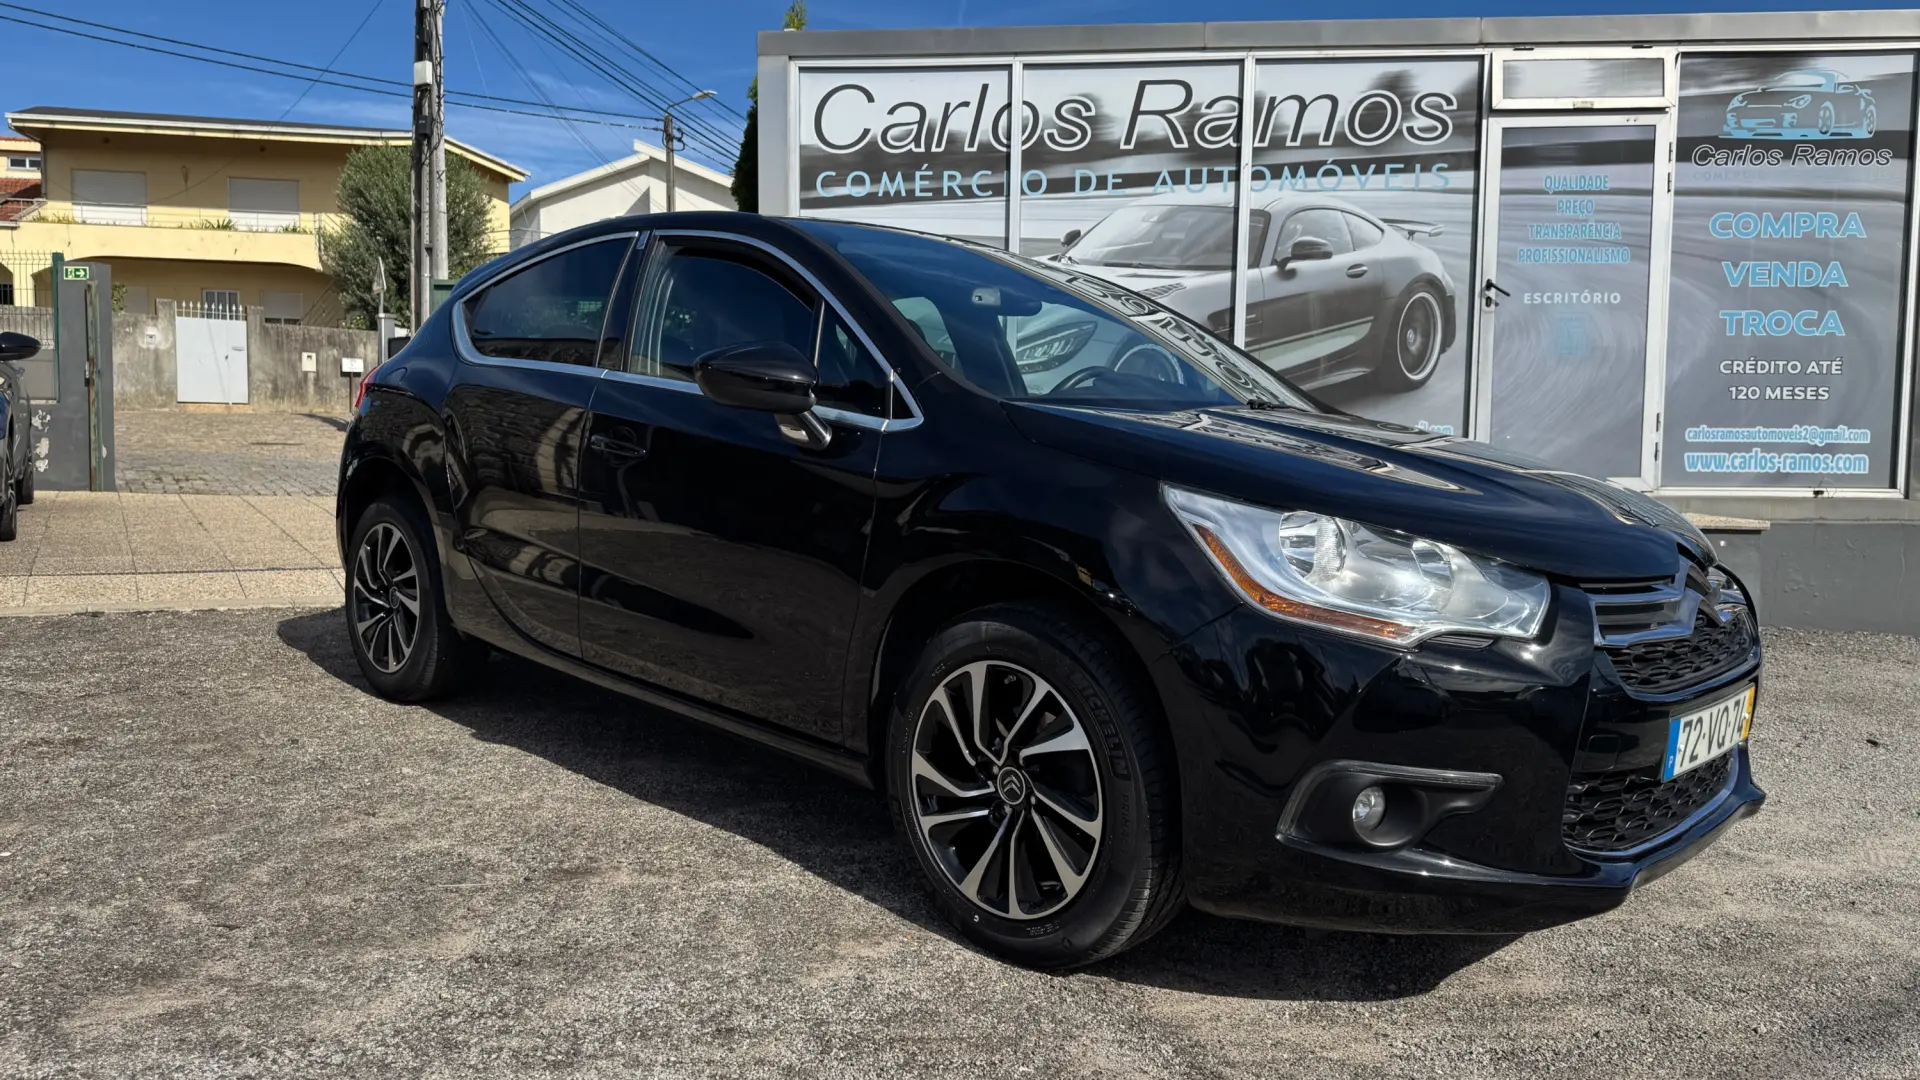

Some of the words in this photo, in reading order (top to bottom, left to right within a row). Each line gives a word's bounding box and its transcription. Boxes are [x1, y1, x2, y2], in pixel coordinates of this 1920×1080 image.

[813, 82, 1098, 154] Carlos
[1119, 77, 1457, 151] Ramos
[1692, 144, 1784, 167] Carlos
[1791, 144, 1893, 167] Ramos
[815, 163, 1048, 198] COMÉRCIO
[1074, 168, 1126, 197] DE
[1152, 157, 1451, 194] AUTOMÓVEIS
[1544, 175, 1610, 194] QUALIDADE
[1556, 199, 1596, 218] PREÇO
[1528, 219, 1622, 240] TRANSPARÊNCIA
[1709, 212, 1867, 239] COMPRA
[1517, 247, 1632, 264] PROFISSIONALISMO
[1721, 261, 1849, 287] VENDA
[1523, 289, 1621, 304] ESCRITÓRIO
[1719, 310, 1846, 337] TROCA
[1719, 357, 1802, 375] CRÉDITO
[1806, 357, 1844, 375] ATÉ
[1728, 386, 1761, 400] 120
[1765, 386, 1830, 400] MESES
[1685, 424, 1871, 446] carlosramosautomoveis2@gmail.com
[1684, 448, 1869, 474] www.carlos-ramos.com
